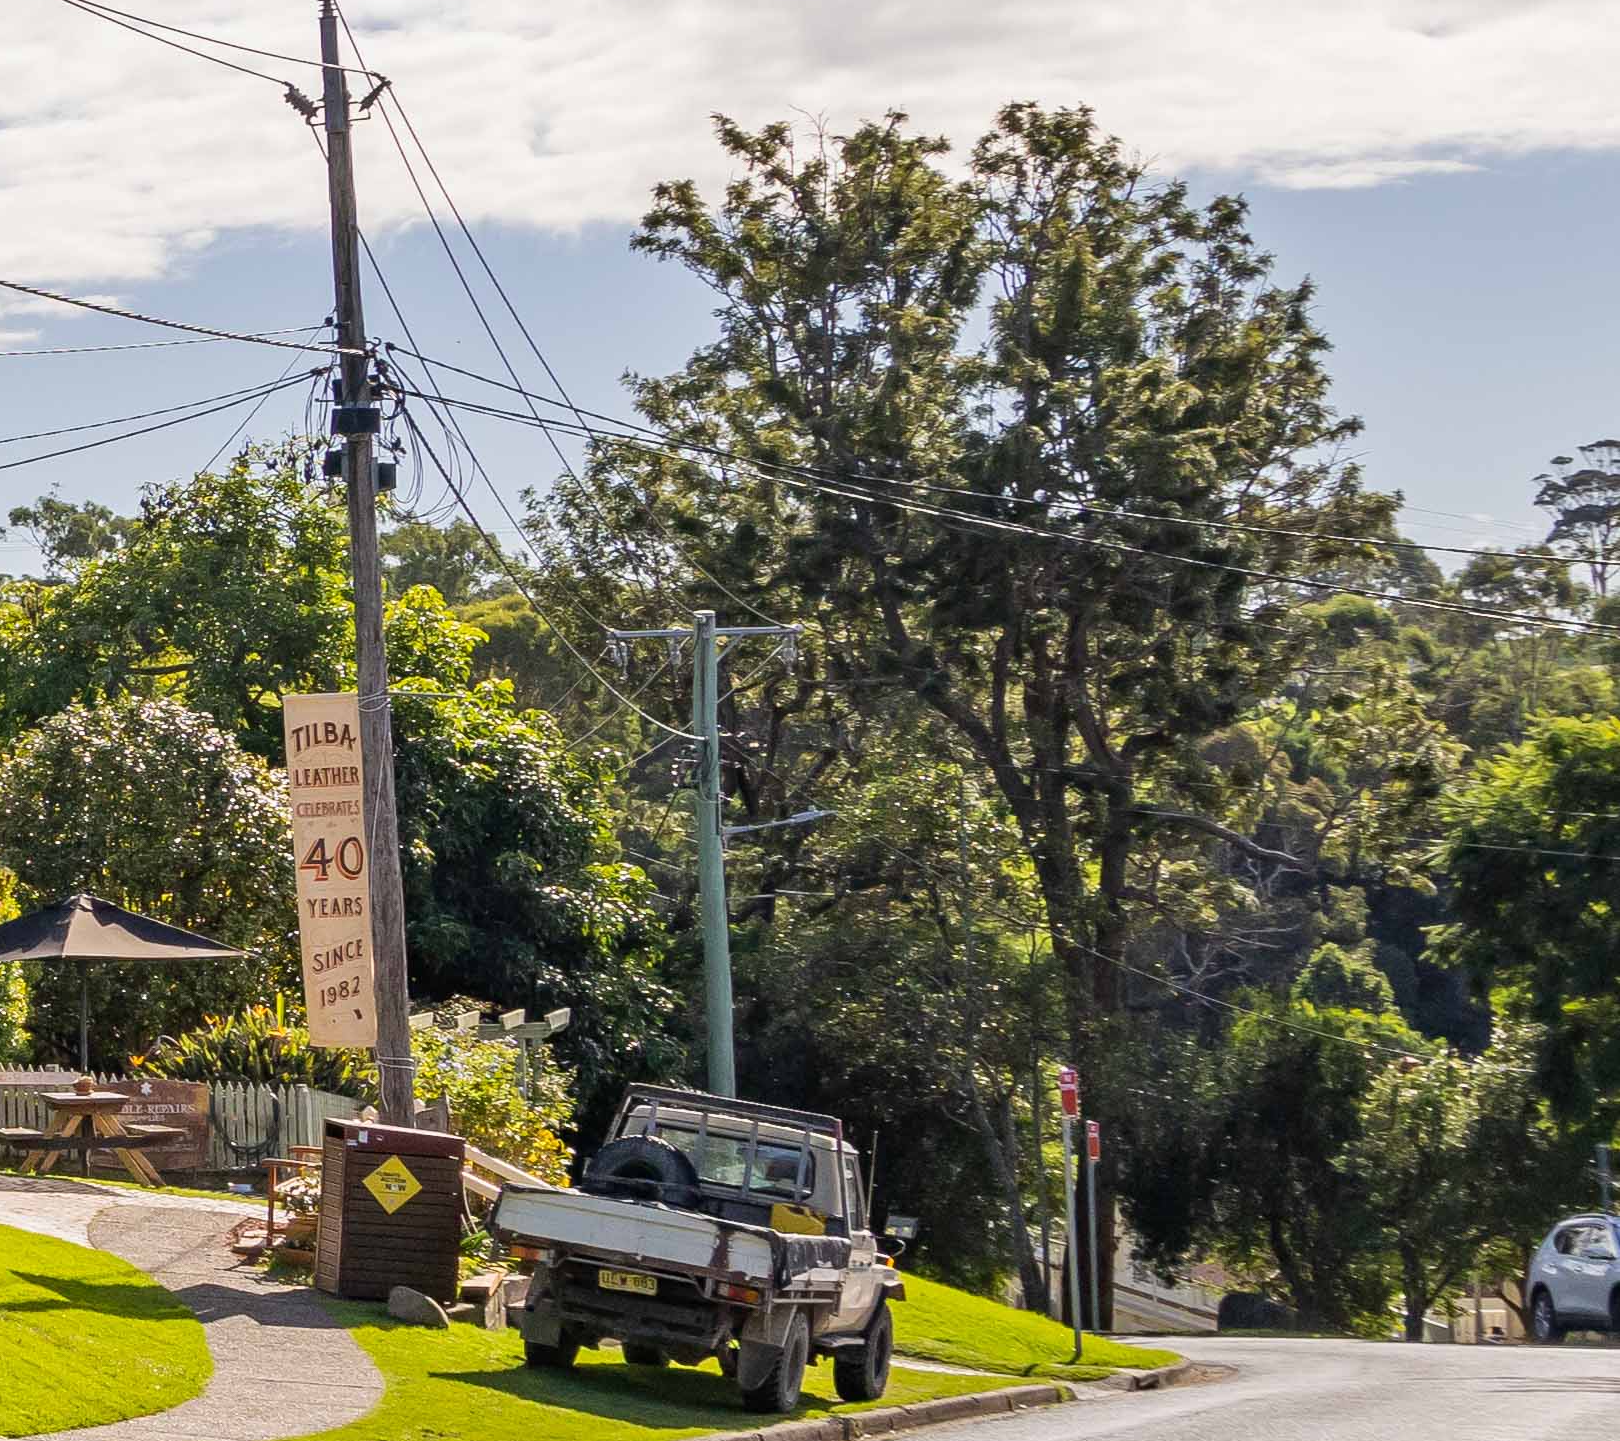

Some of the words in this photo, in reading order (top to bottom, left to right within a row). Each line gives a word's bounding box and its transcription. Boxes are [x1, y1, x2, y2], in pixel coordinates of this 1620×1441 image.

[292, 721, 357, 752] TILBA
[295, 766, 360, 787] LEATHER
[296, 800, 359, 818] CELEBRATES
[299, 836, 364, 882] 40
[307, 897, 363, 919] YEARS
[312, 938, 363, 974] SINCE
[320, 976, 360, 1008] 1982
